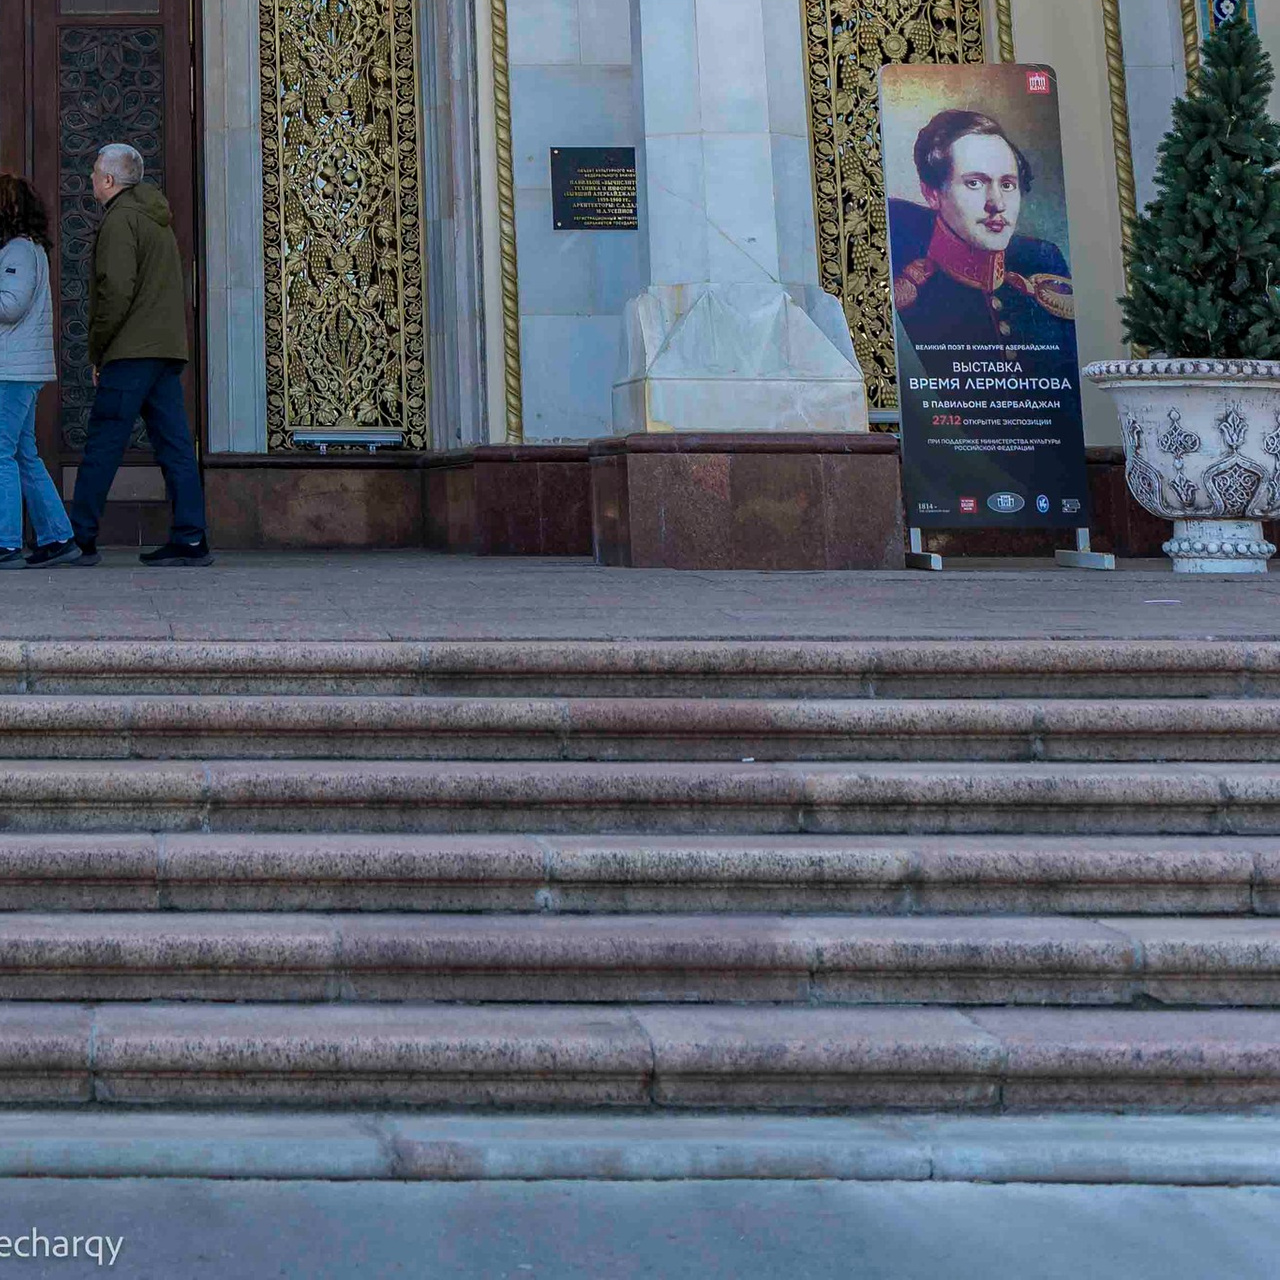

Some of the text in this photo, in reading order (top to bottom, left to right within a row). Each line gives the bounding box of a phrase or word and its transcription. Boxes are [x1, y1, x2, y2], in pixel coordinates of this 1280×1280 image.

[915, 343, 947, 351] ВЕЛИКИЙ
[1005, 343, 1060, 351] АЗЕРБАЙДЖАНА
[952, 361, 1023, 373] ВЫСТАВКА
[909, 377, 1072, 390] ВРЕМЯ ЛЕРМОНТОВА
[922, 399, 1061, 409] В ПАВИЛЬОНЕ АЗЕРБАЙДЖАН
[932, 415, 1052, 427] 27.12 ОТКРЫТИЕ ЭКСПОЗИЦИИ
